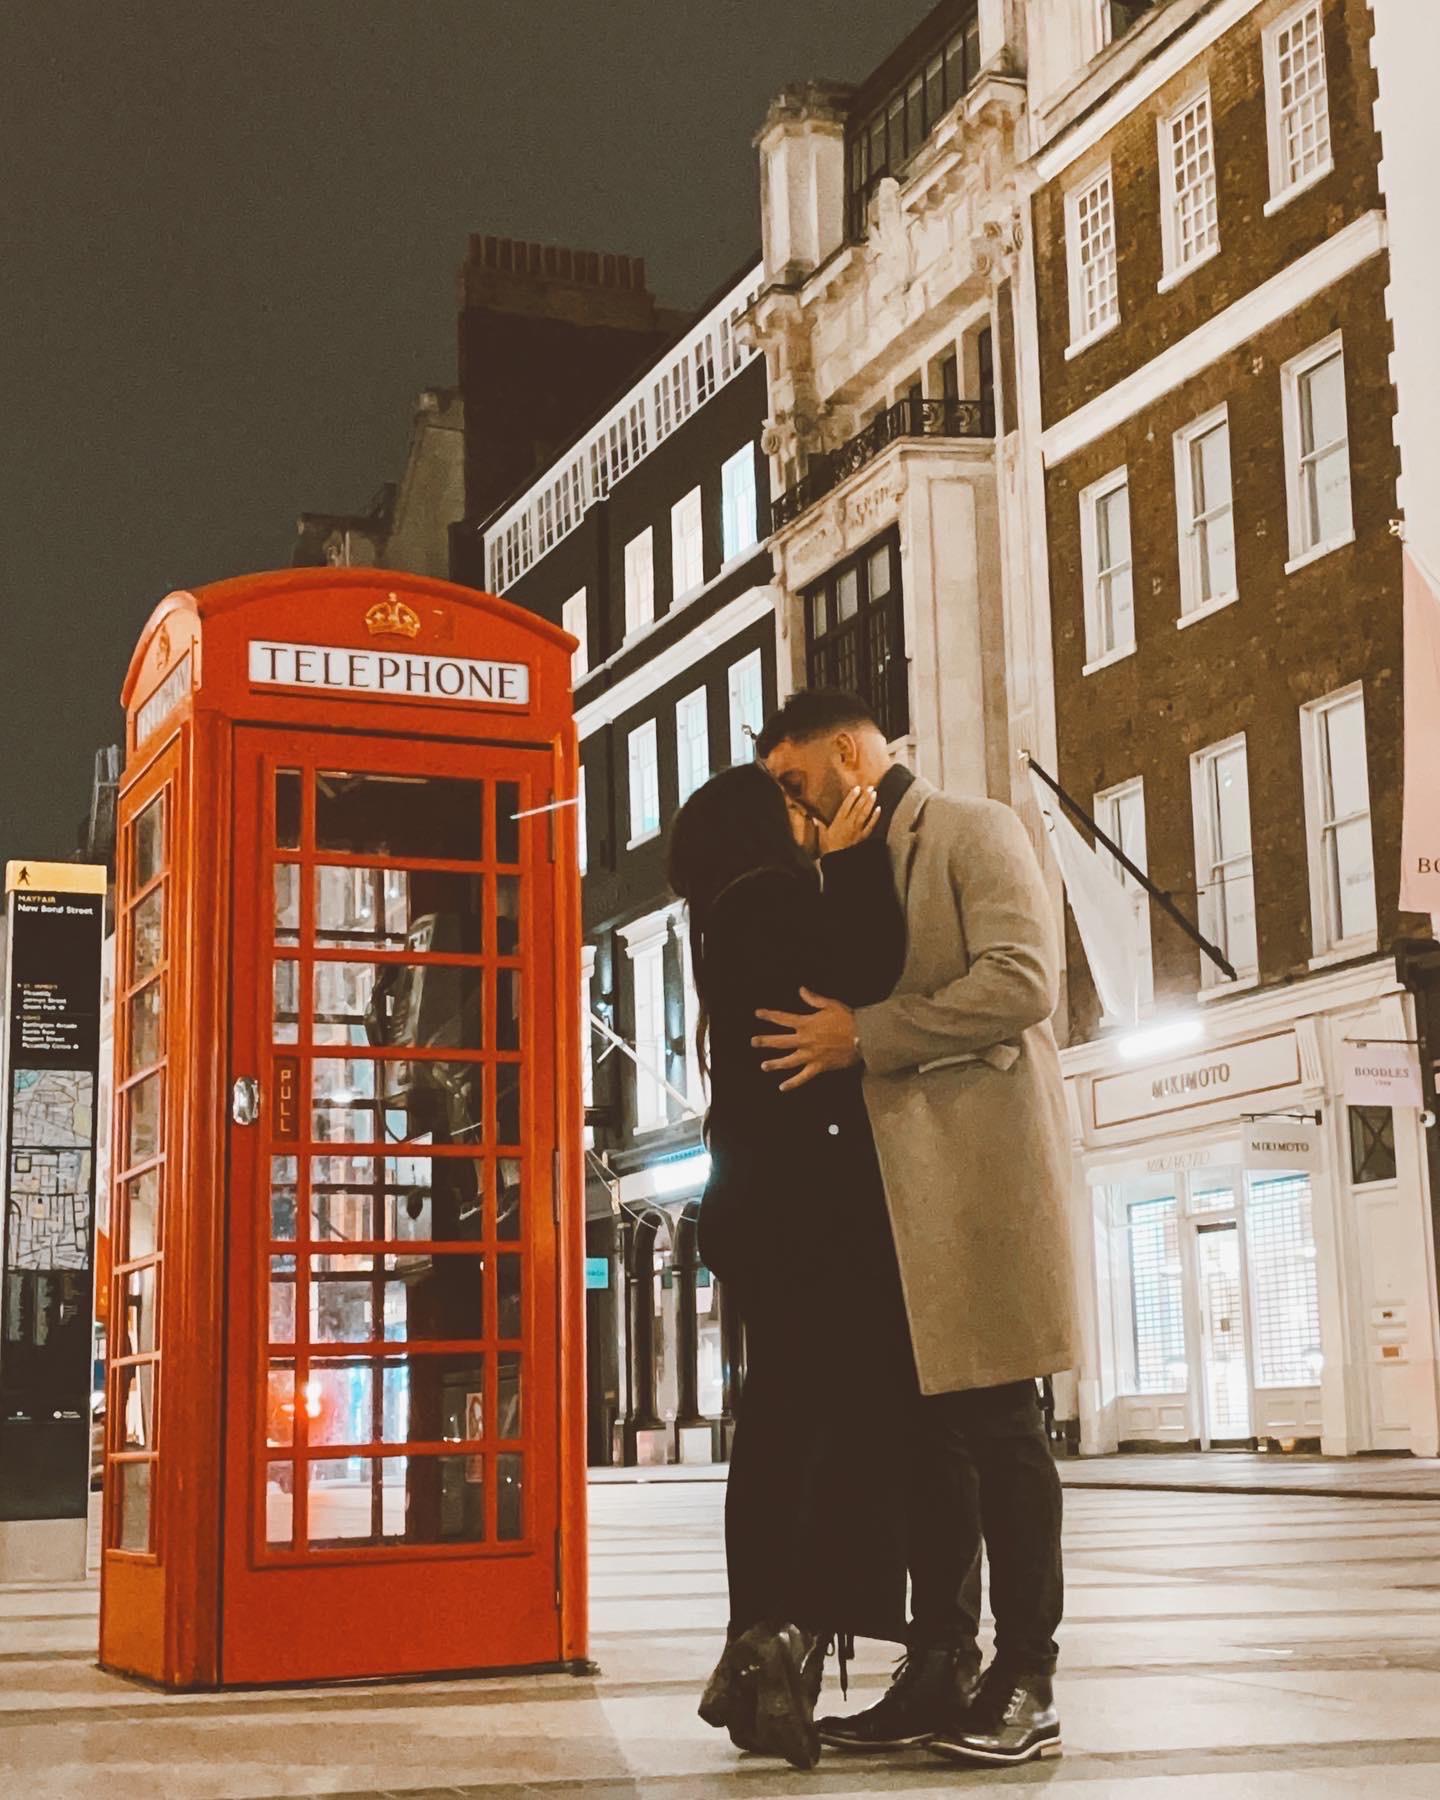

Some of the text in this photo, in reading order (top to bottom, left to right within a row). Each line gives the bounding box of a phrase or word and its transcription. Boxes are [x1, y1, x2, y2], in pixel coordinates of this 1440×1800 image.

[261, 646, 519, 700] TELEPHONE
[18, 895, 56, 904] MAYFAIR
[17, 904, 94, 915] New Bond Street
[1355, 1067, 1409, 1078] BOODLES
[1152, 1063, 1230, 1098] MIKIMOTO
[281, 1069, 291, 1132] PULL
[1251, 1141, 1310, 1152] MIKIMOTO
